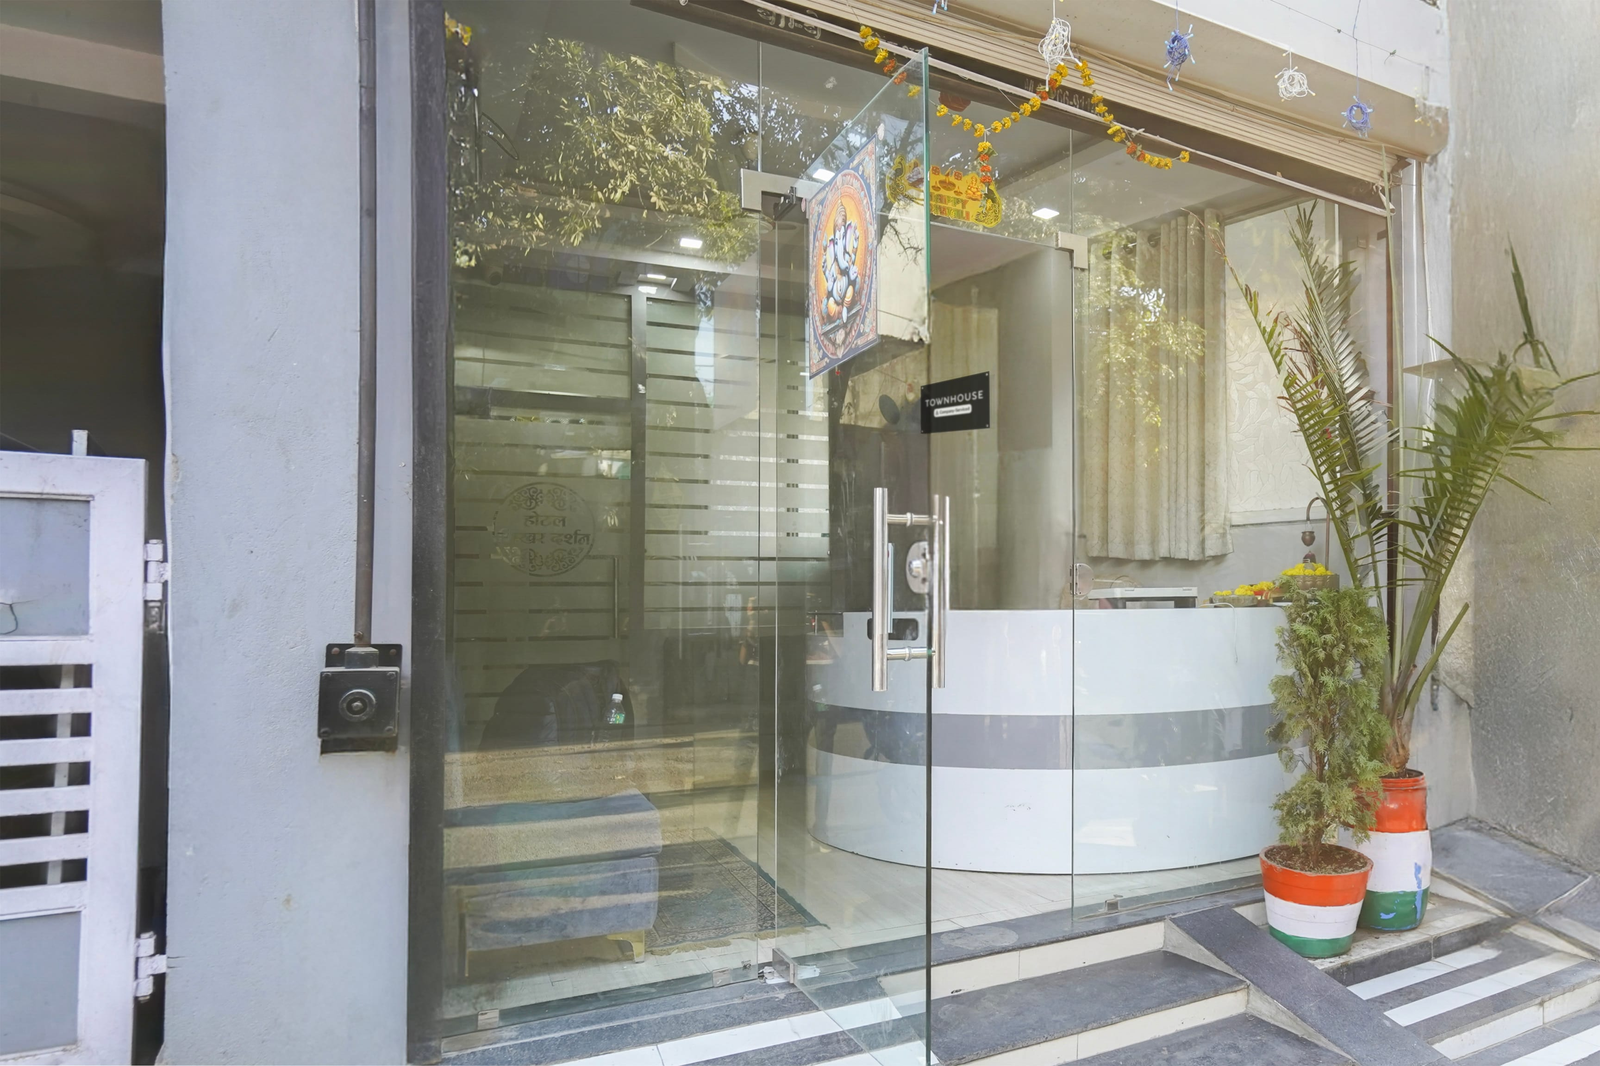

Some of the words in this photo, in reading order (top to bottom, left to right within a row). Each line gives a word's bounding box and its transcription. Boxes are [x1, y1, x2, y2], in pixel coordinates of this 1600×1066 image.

[925, 390, 984, 407] TOWNHOUSE
[523, 510, 567, 527] होटल
[550, 529, 591, 546] दर्शन
